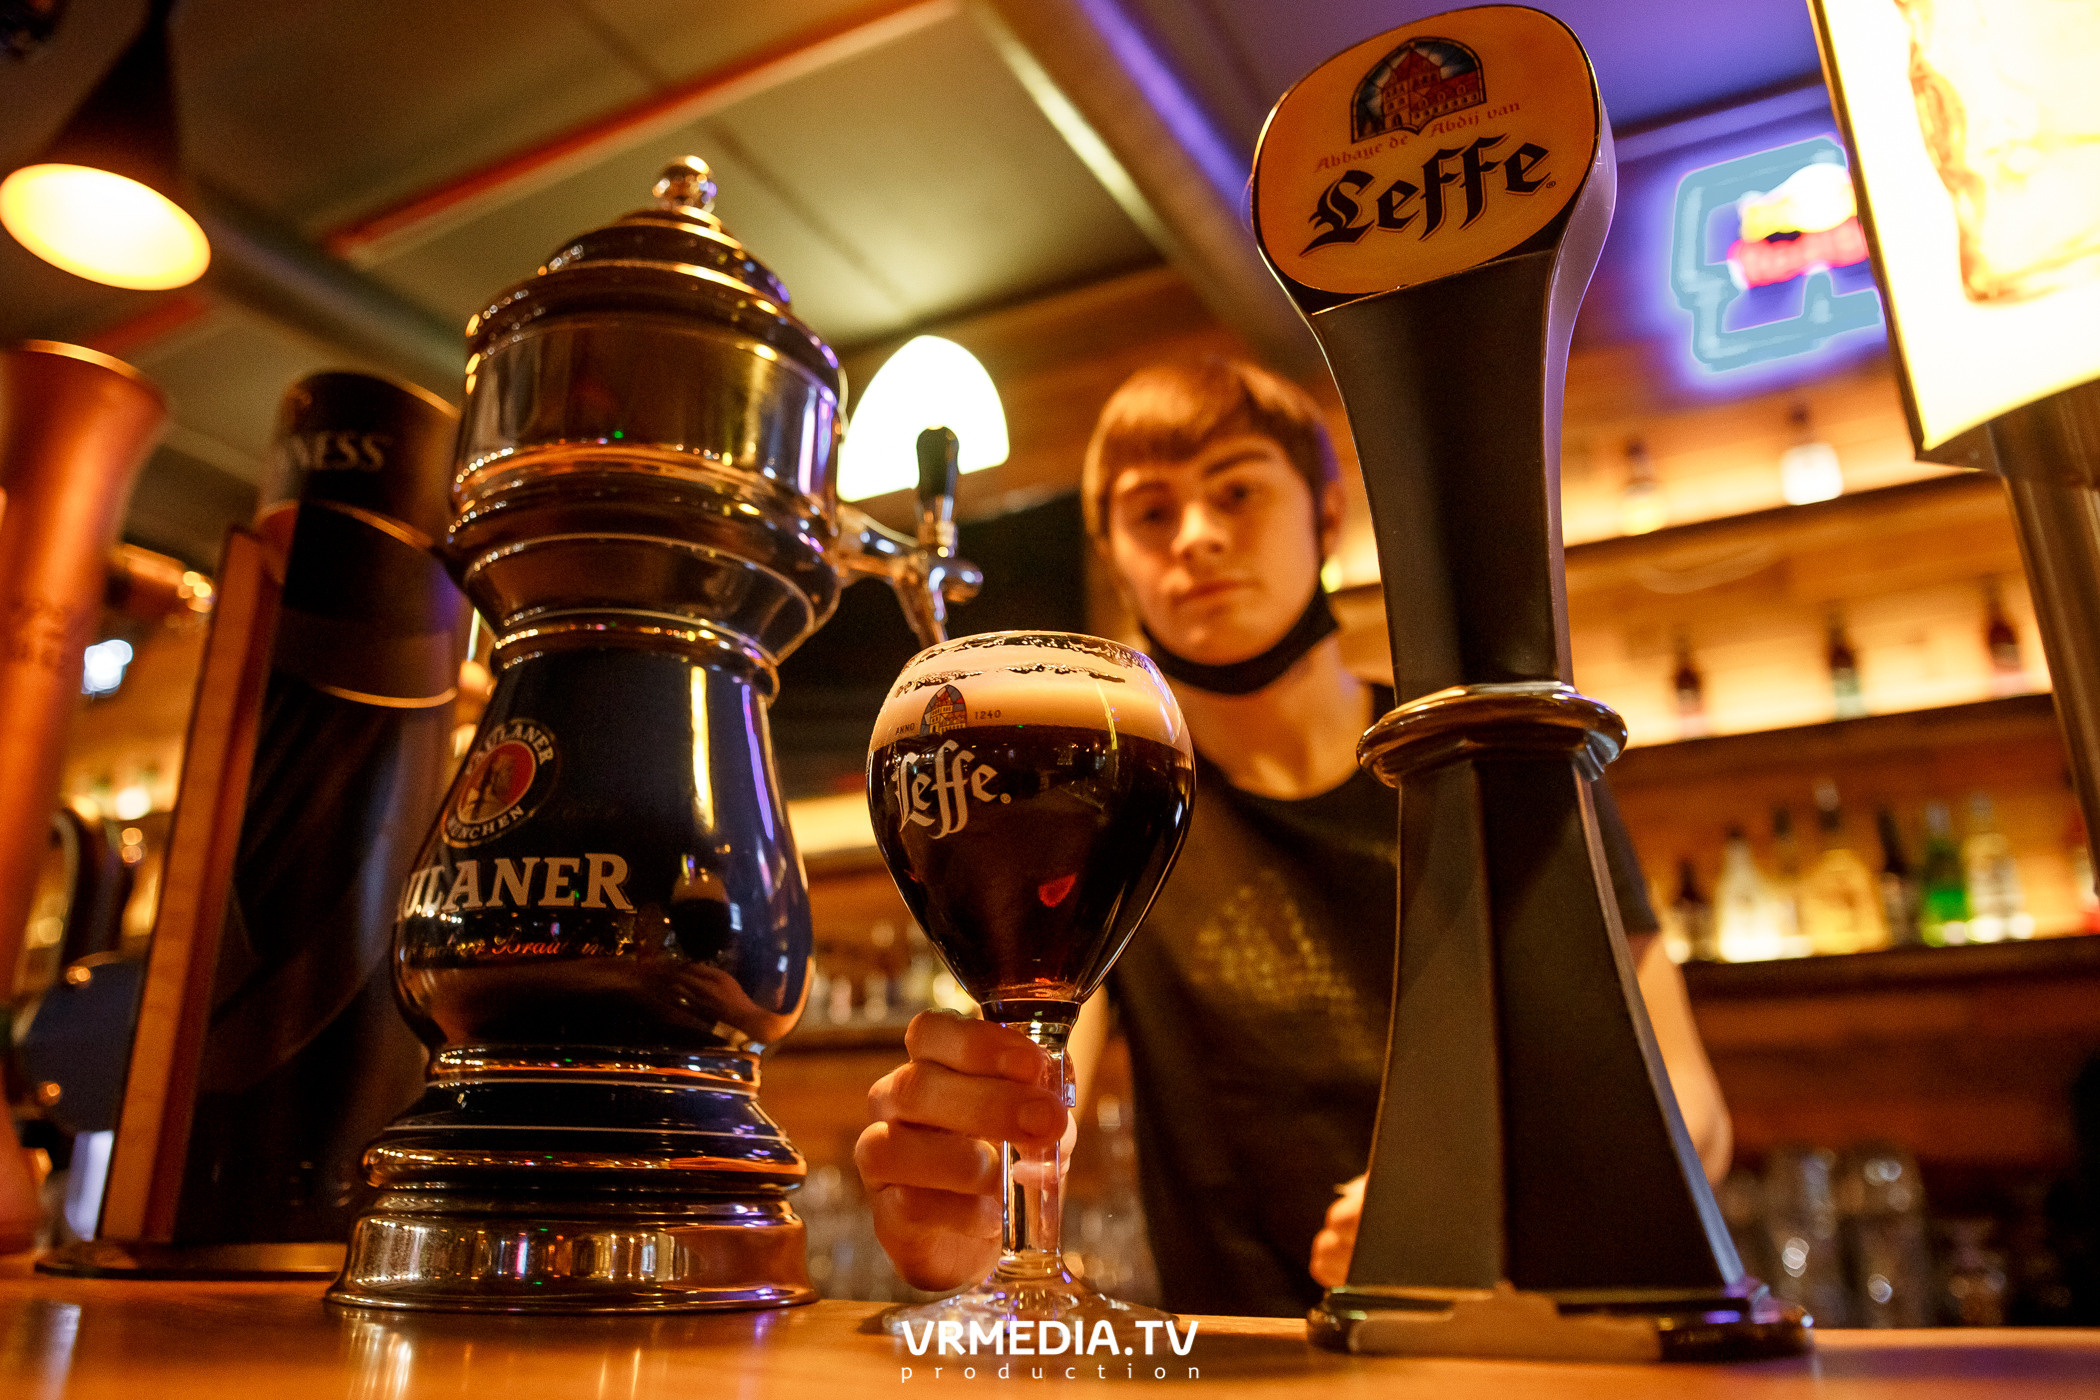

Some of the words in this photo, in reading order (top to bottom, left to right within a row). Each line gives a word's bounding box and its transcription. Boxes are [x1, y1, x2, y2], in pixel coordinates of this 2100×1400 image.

[1314, 143, 1383, 173] Abbaye
[1389, 133, 1409, 149] de
[1429, 111, 1480, 139] Abdij
[1487, 102, 1521, 120] van
[1300, 133, 1550, 258] Leffe
[895, 722, 916, 736] ANNO
[974, 709, 1002, 720] 1240
[891, 739, 999, 840] Leffe
[402, 853, 637, 919] ULANER
